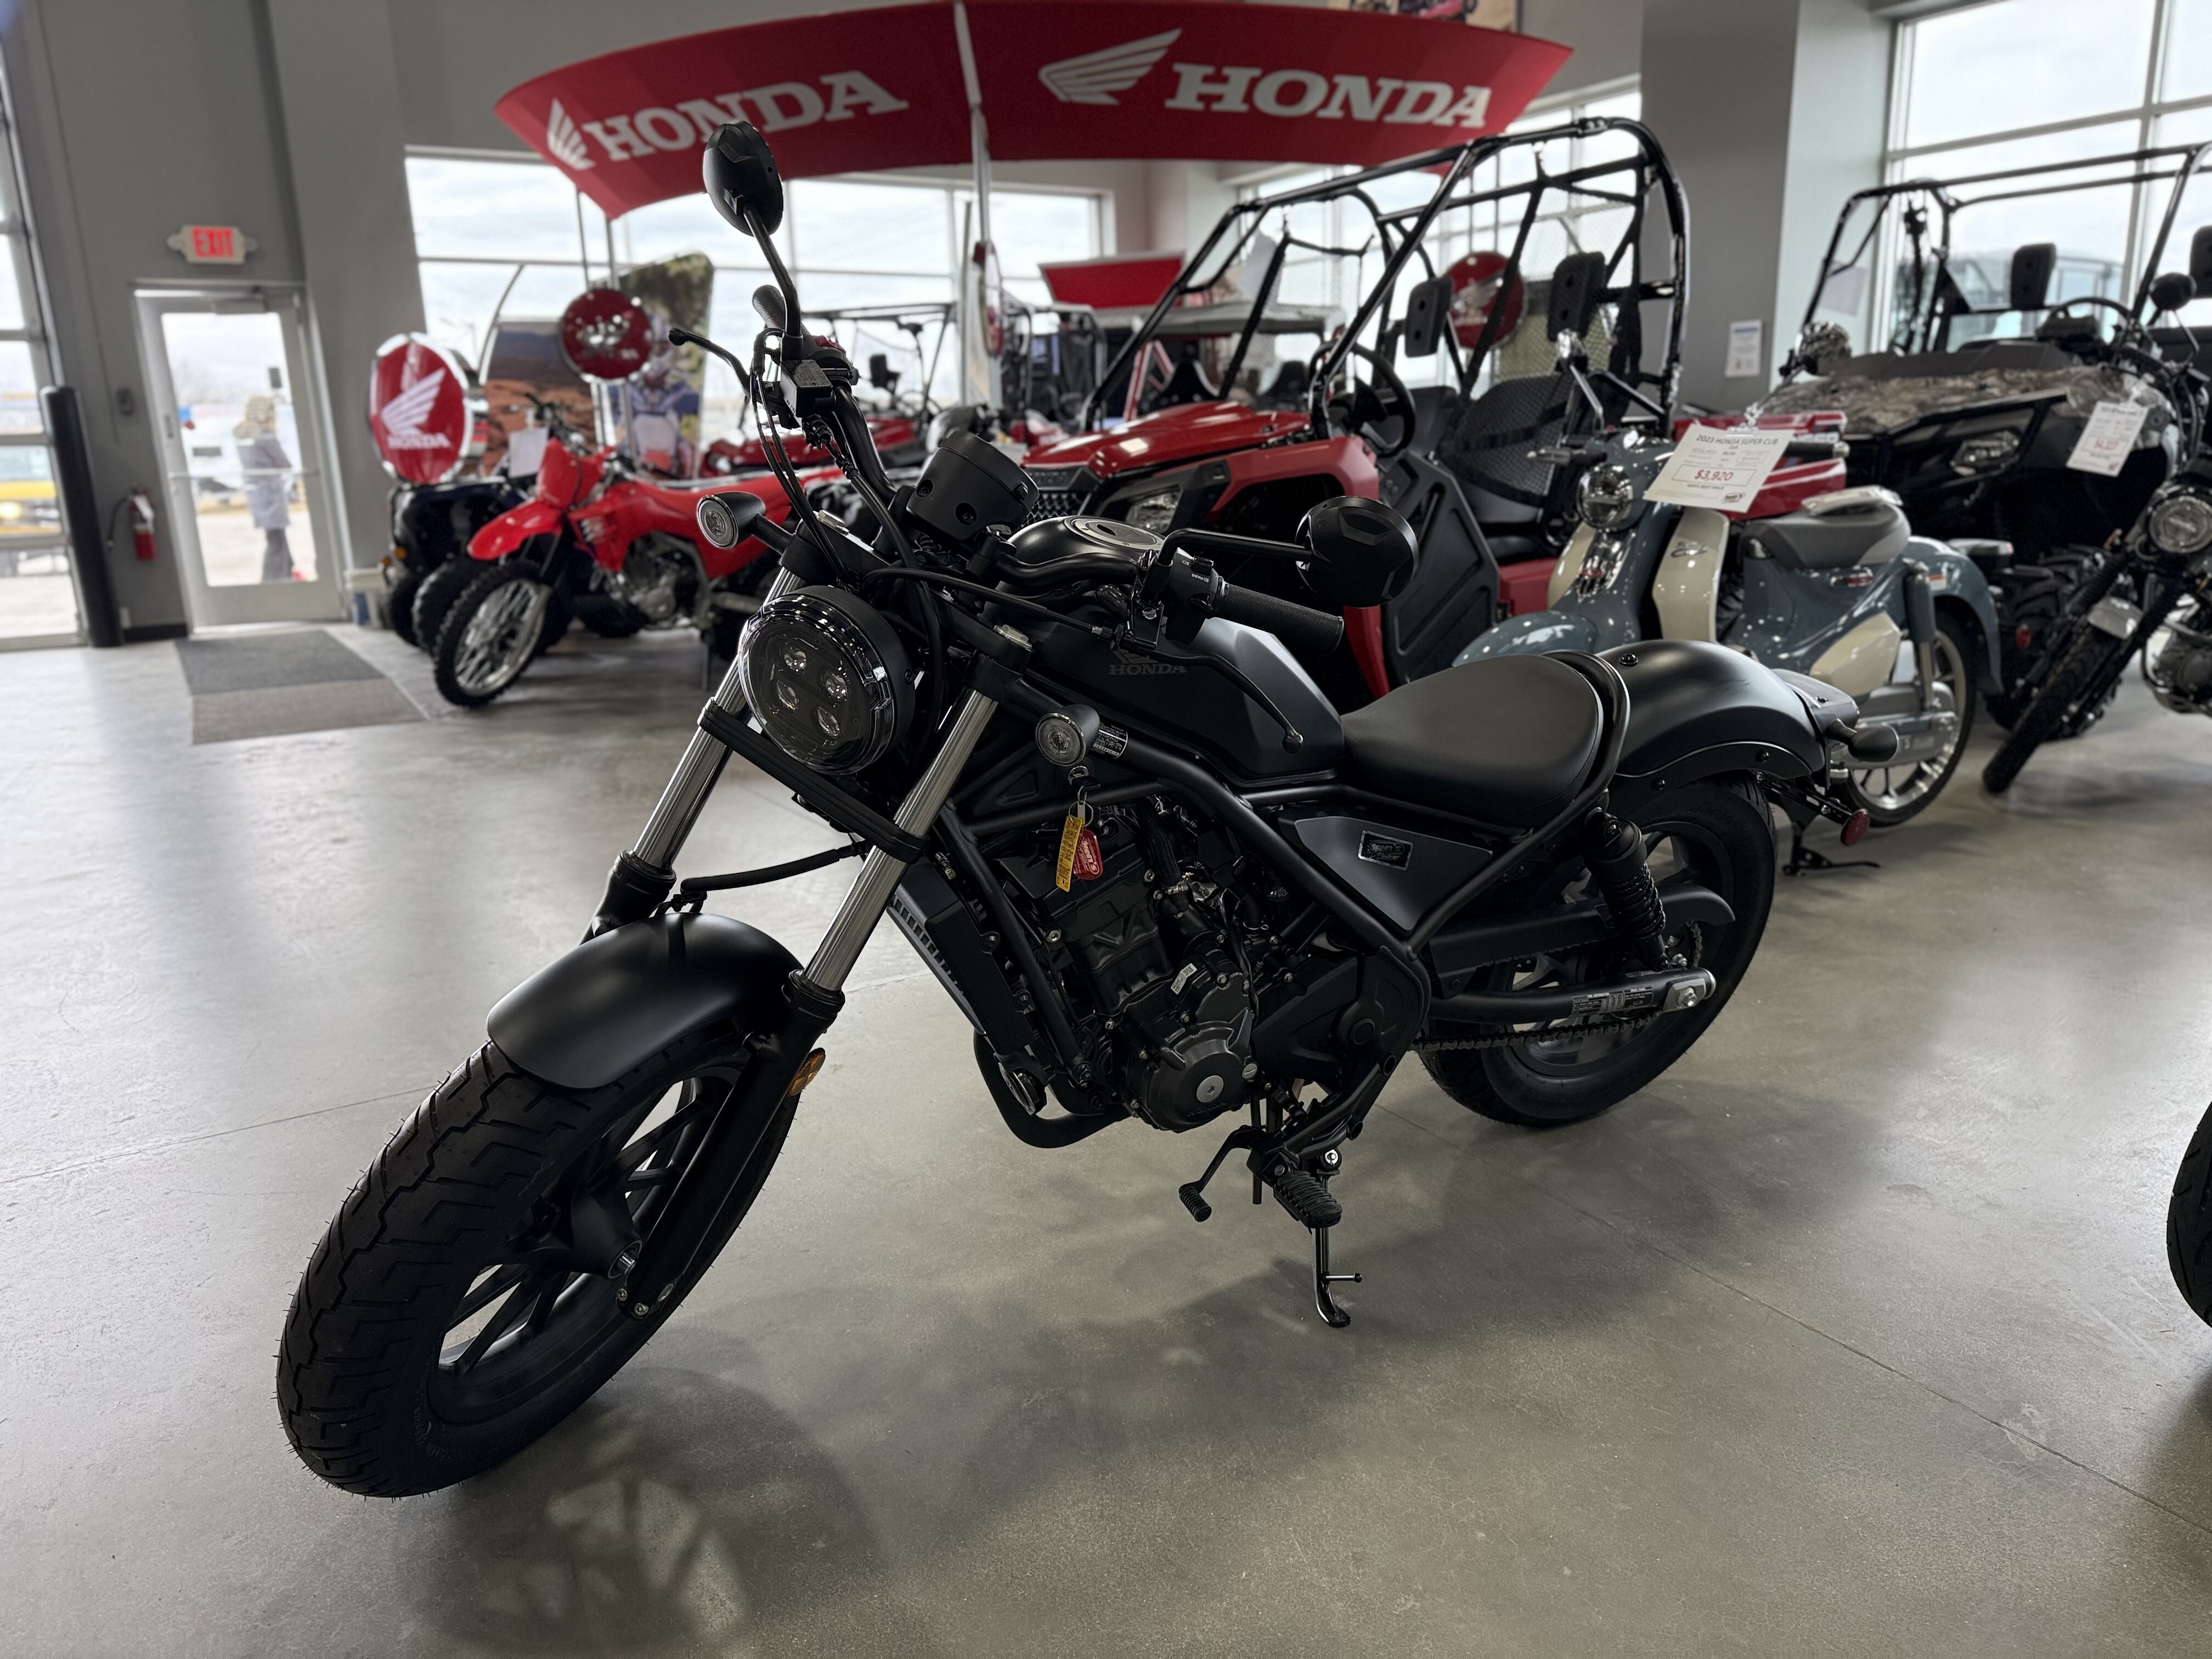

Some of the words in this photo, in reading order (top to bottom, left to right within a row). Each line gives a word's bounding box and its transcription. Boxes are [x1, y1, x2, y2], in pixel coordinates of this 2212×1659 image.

[1164, 62, 1492, 128] HONDA
[582, 70, 910, 161] HONDA
[193, 228, 233, 257] EXIT
[1696, 435, 1715, 443] 2023
[1694, 469, 1734, 481] $3,920
[1109, 664, 1188, 675] HONDA
